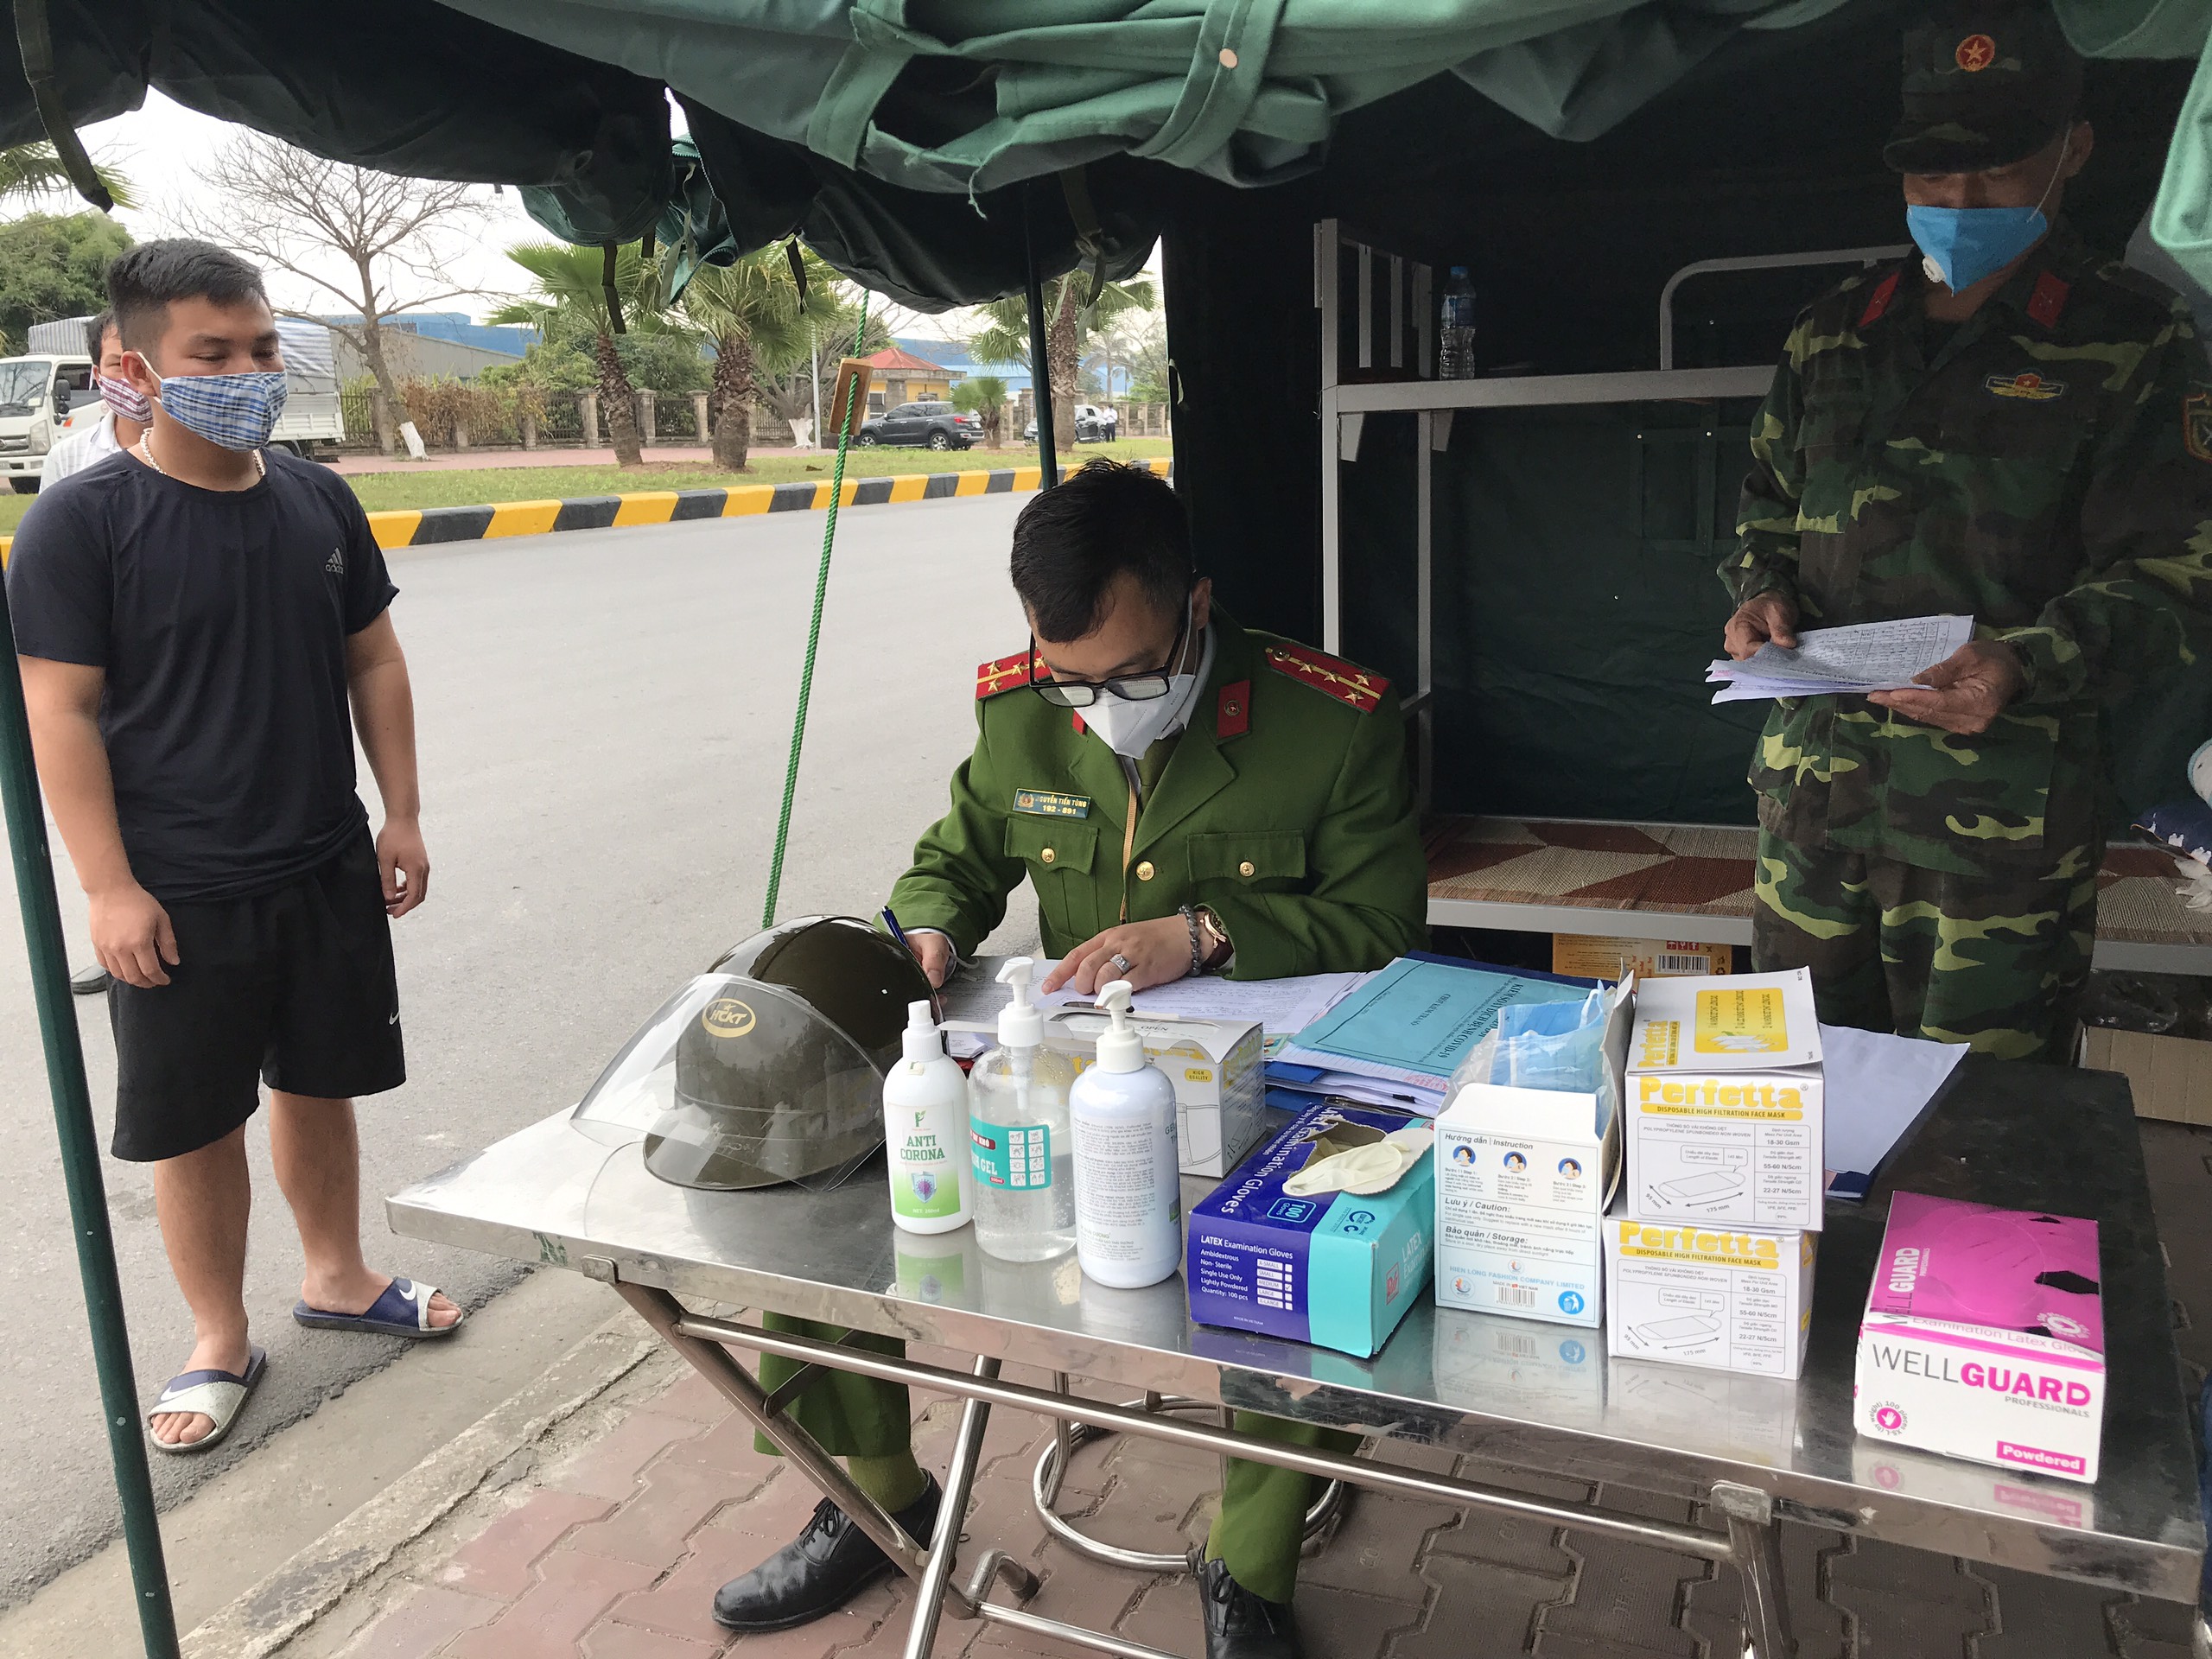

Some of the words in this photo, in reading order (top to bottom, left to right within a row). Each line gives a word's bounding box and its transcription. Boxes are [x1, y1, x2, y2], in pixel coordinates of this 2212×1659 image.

[1437, 1034, 1468, 1058] COVID-19
[1639, 1076, 1803, 1109] Perfetta
[1656, 1105, 1694, 1115] DISPOSABLE
[1713, 1108, 1750, 1117] FILTRATION
[1767, 1110, 1786, 1119] MASK
[906, 1135, 937, 1147] ANTI
[978, 1136, 990, 1147] KHÔ
[1444, 1132, 1471, 1143] Hướng
[1472, 1135, 1487, 1144] dẫn
[1492, 1137, 1533, 1150] Instruction
[900, 1147, 945, 1161] CORONA
[980, 1158, 998, 1175] GEL
[1221, 1179, 1263, 1214] Gloves
[1445, 1197, 1460, 1206] Lưu
[1462, 1198, 1467, 1208] ý
[1474, 1200, 1510, 1212] Caution:
[1645, 1192, 1654, 1202] 95
[1651, 1198, 1662, 1209] mm
[1285, 1204, 1306, 1218] 100
[1717, 1203, 1730, 1211] mm
[1445, 1224, 1462, 1235] Bảo
[1464, 1228, 1484, 1239] quản
[1491, 1232, 1528, 1247] Storage:
[1619, 1221, 1779, 1258] Perfetta
[1200, 1234, 1223, 1246] LATEX
[1224, 1239, 1267, 1255] Examination
[1268, 1247, 1293, 1260] Gloves
[1402, 1229, 1422, 1262] LATEX
[1199, 1248, 1239, 1262] Ambidextrous
[1637, 1248, 1673, 1258] DISPOSABLE
[1691, 1252, 1726, 1262] FILTRATION
[1199, 1258, 1213, 1267] Non-
[1214, 1261, 1232, 1270] Sterile
[1258, 1260, 1279, 1268] X-SMALL
[1200, 1268, 1217, 1278] Single
[1229, 1273, 1243, 1282] Only
[1449, 1265, 1465, 1274] HIEN
[1467, 1268, 1486, 1276] LONG
[1488, 1271, 1517, 1281] FASHION
[1520, 1275, 1554, 1286] COMPANY
[1556, 1281, 1585, 1290] LIMITED
[1200, 1276, 1219, 1287] Lightly
[1220, 1280, 1248, 1292] Powdered
[1201, 1286, 1227, 1297] Quantity:
[1258, 1279, 1279, 1288] MEDIUM
[1756, 1334, 1777, 1343] N/5cm
[1912, 1317, 2002, 1339] Examination
[2007, 1332, 2047, 1348] Latex
[1623, 1333, 1631, 1343] 95
[1629, 1339, 1639, 1351] mm
[1694, 1347, 1706, 1356] mm
[1872, 1344, 2091, 1407] WELLGUARD
[2005, 1395, 2090, 1419] PROFESSIONALS
[1885, 1401, 1900, 1410] 100
[1899, 1409, 1908, 1430] pieces
[2002, 1445, 2081, 1471] Powdered
